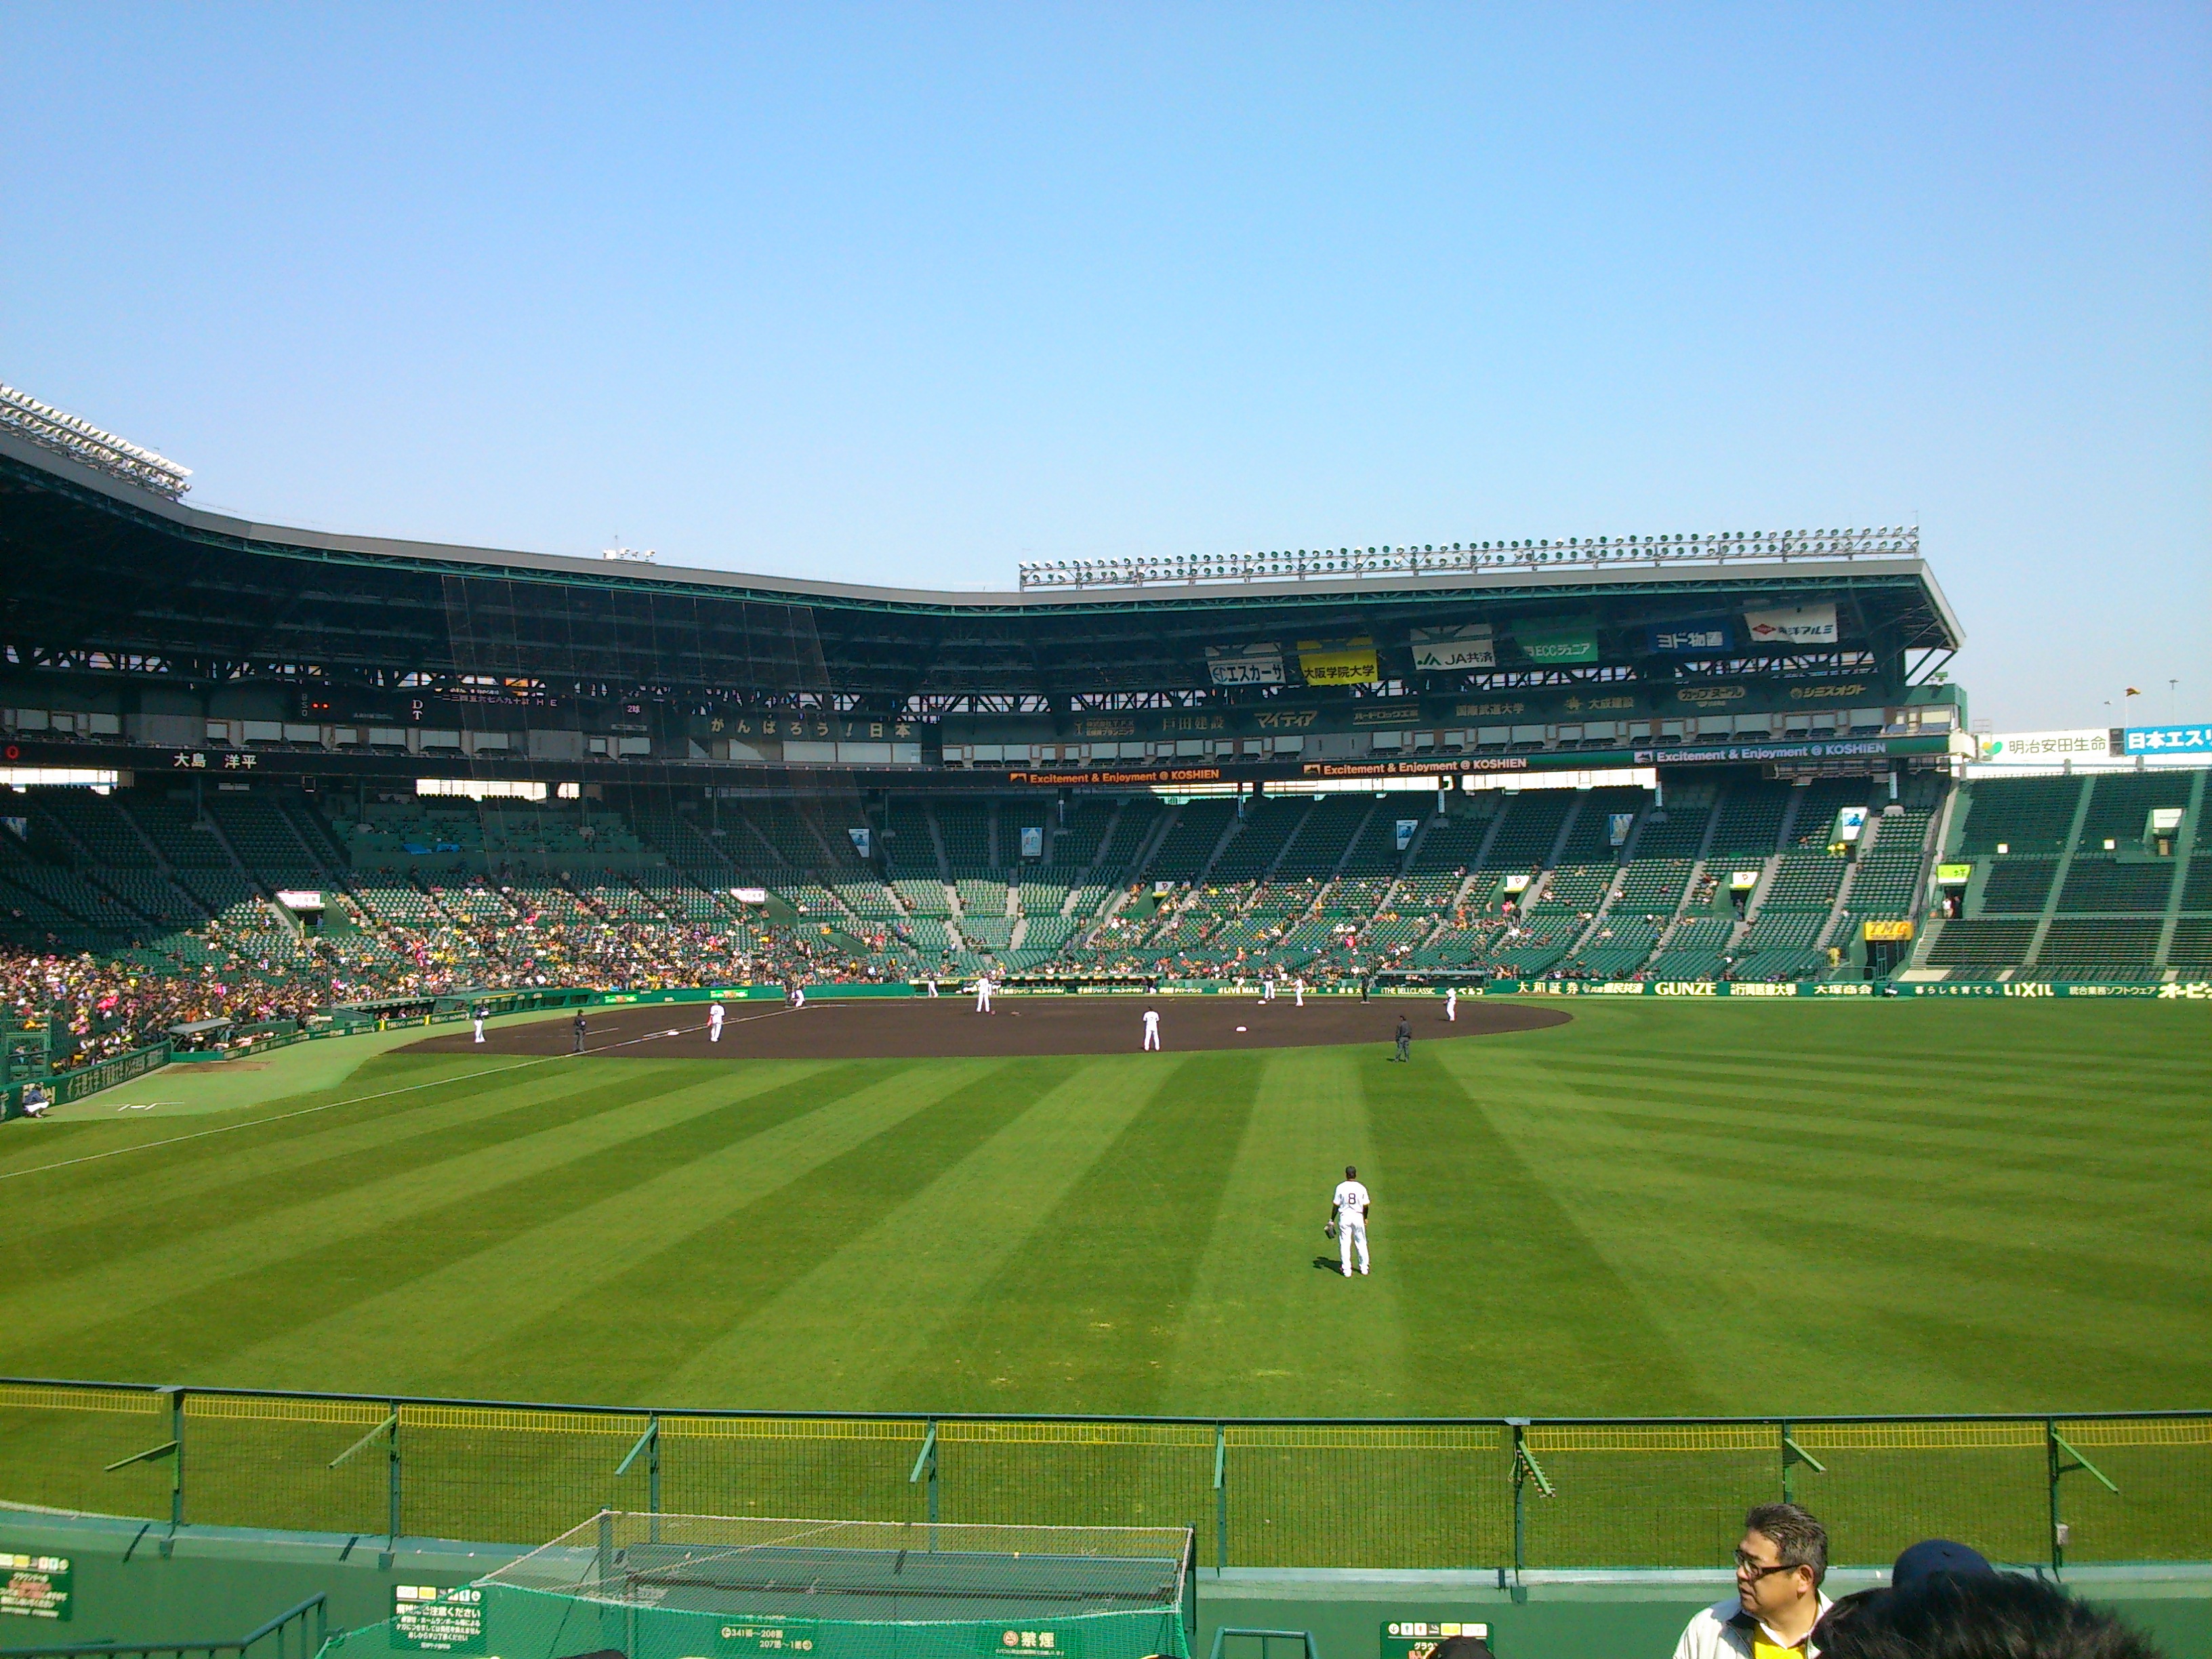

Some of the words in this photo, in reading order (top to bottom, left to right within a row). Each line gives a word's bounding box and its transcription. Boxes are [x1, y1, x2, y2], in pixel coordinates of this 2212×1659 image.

[1656, 631, 1723, 649] ヨド物置
[1535, 642, 1591, 657] ECCジュニア
[1445, 651, 1493, 665] JA共済
[1227, 663, 1282, 682] エスカーサ
[1304, 664, 1375, 679] 大阪学院大学
[412, 699, 424, 710] D
[412, 710, 423, 720] T
[1162, 716, 1225, 732] 戸田建設
[2009, 735, 2106, 754] 明治安田生命
[1656, 750, 1726, 762] Excitement
[1729, 749, 1739, 760] &
[1741, 747, 1808, 760] Enjoyment
[1811, 747, 1822, 756] @
[1826, 743, 1887, 756] KOSHIEN
[173, 752, 206, 768] 大島
[224, 754, 258, 770] 洋平
[1324, 763, 1385, 775] Excitement
[1387, 762, 1395, 773] &
[1399, 761, 1458, 774] Enjoyment
[1460, 760, 1471, 771] @
[1473, 758, 1528, 769] KOSHIEN
[1030, 773, 1089, 784] Excitement
[1091, 773, 1100, 783] &
[1102, 771, 1157, 784] Enjoyment
[1160, 771, 1169, 781] @
[1171, 769, 1219, 779] KOSHIEN
[1870, 922, 1908, 935] TMG
[1517, 981, 1579, 995] 大和証券
[1654, 982, 1717, 996] GUNZE
[1814, 984, 1872, 995] 大塚商会
[2003, 982, 2055, 998] LIXIL
[2069, 985, 2157, 996] 統合業務ソフトウェア
[1348, 1193, 1356, 1205] 8
[1021, 1631, 1054, 1648] 禁煙
